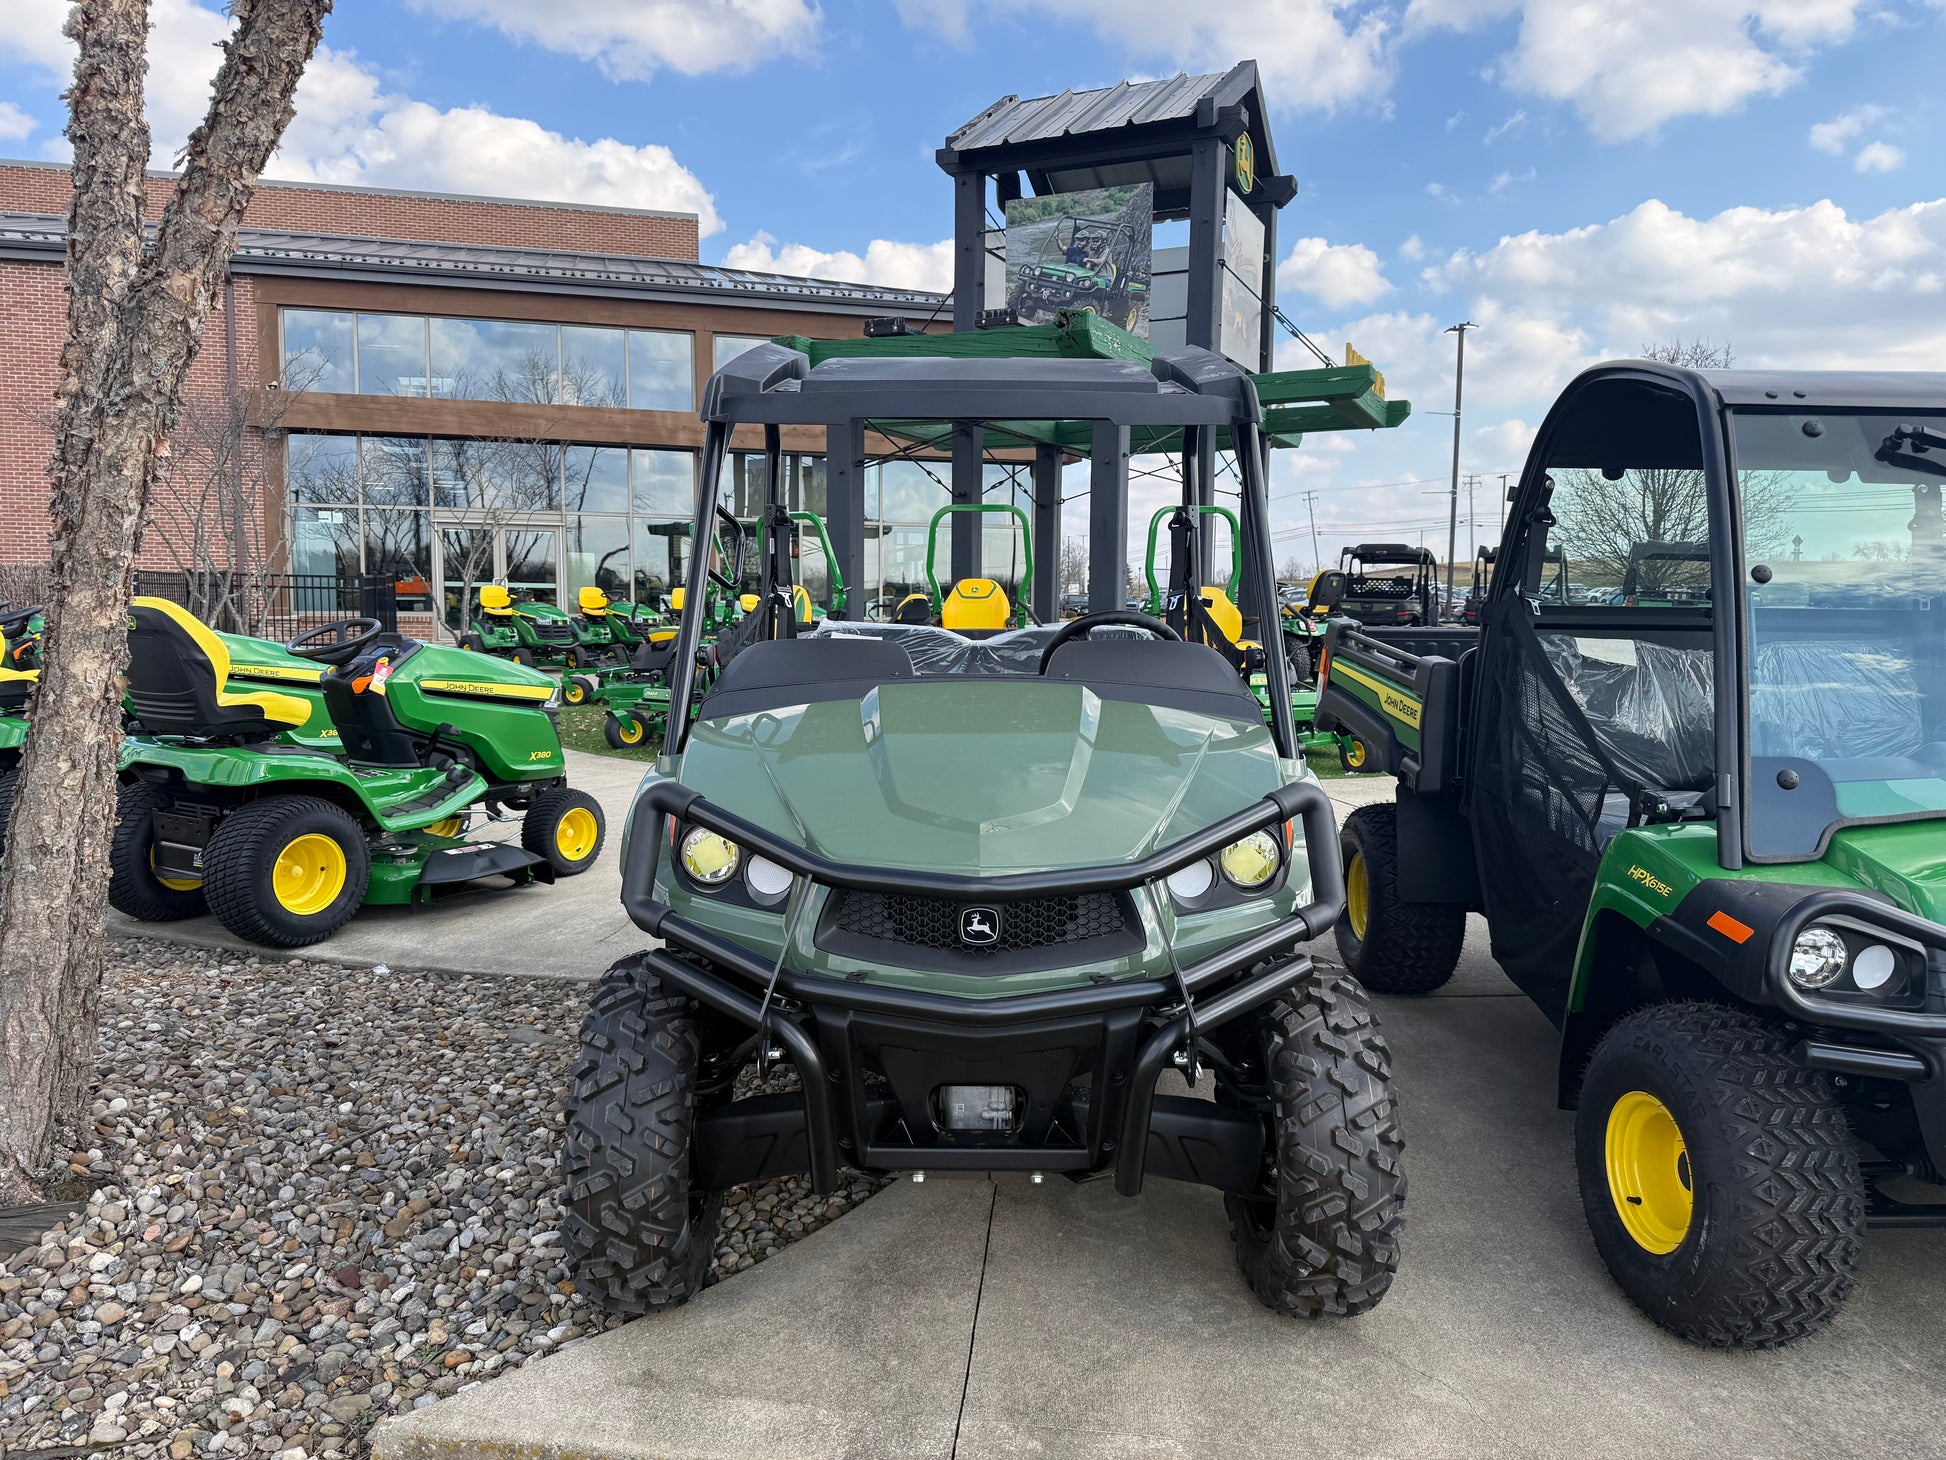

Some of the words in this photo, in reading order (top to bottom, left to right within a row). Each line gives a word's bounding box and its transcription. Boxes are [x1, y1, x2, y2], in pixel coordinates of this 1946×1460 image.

[229, 665, 252, 674] JOHN
[254, 667, 280, 677] DEERE
[444, 682, 466, 692] JOHN
[468, 684, 494, 694] DEERE
[1384, 692, 1399, 710] JOHN
[1399, 699, 1418, 720] DEERE
[320, 729, 339, 738] X38
[529, 751, 551, 760] X380
[1627, 864, 1673, 897] HPX615E
